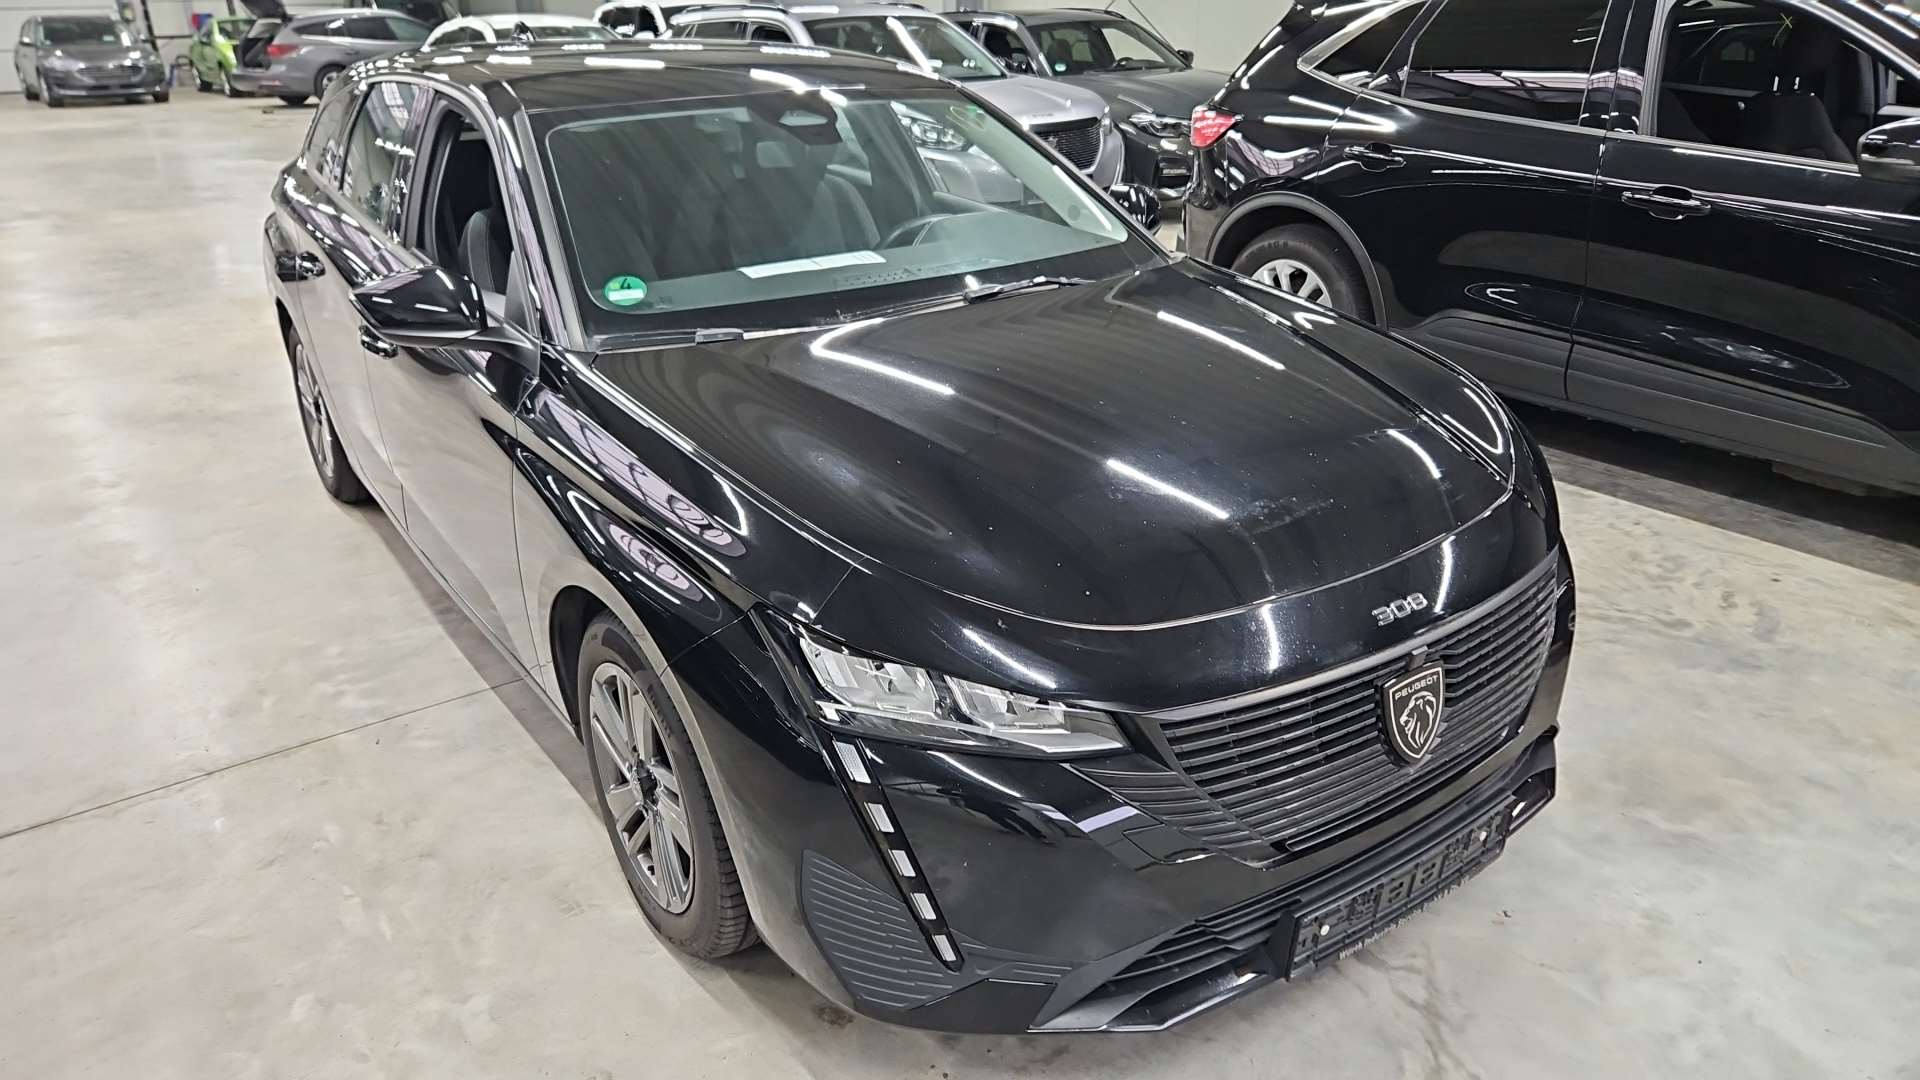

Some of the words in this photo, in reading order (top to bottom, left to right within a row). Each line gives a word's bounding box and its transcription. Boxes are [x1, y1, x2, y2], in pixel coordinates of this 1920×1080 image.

[620, 277, 633, 289] 4
[1371, 592, 1428, 627] 308
[1394, 674, 1438, 701] PEUGEOT
